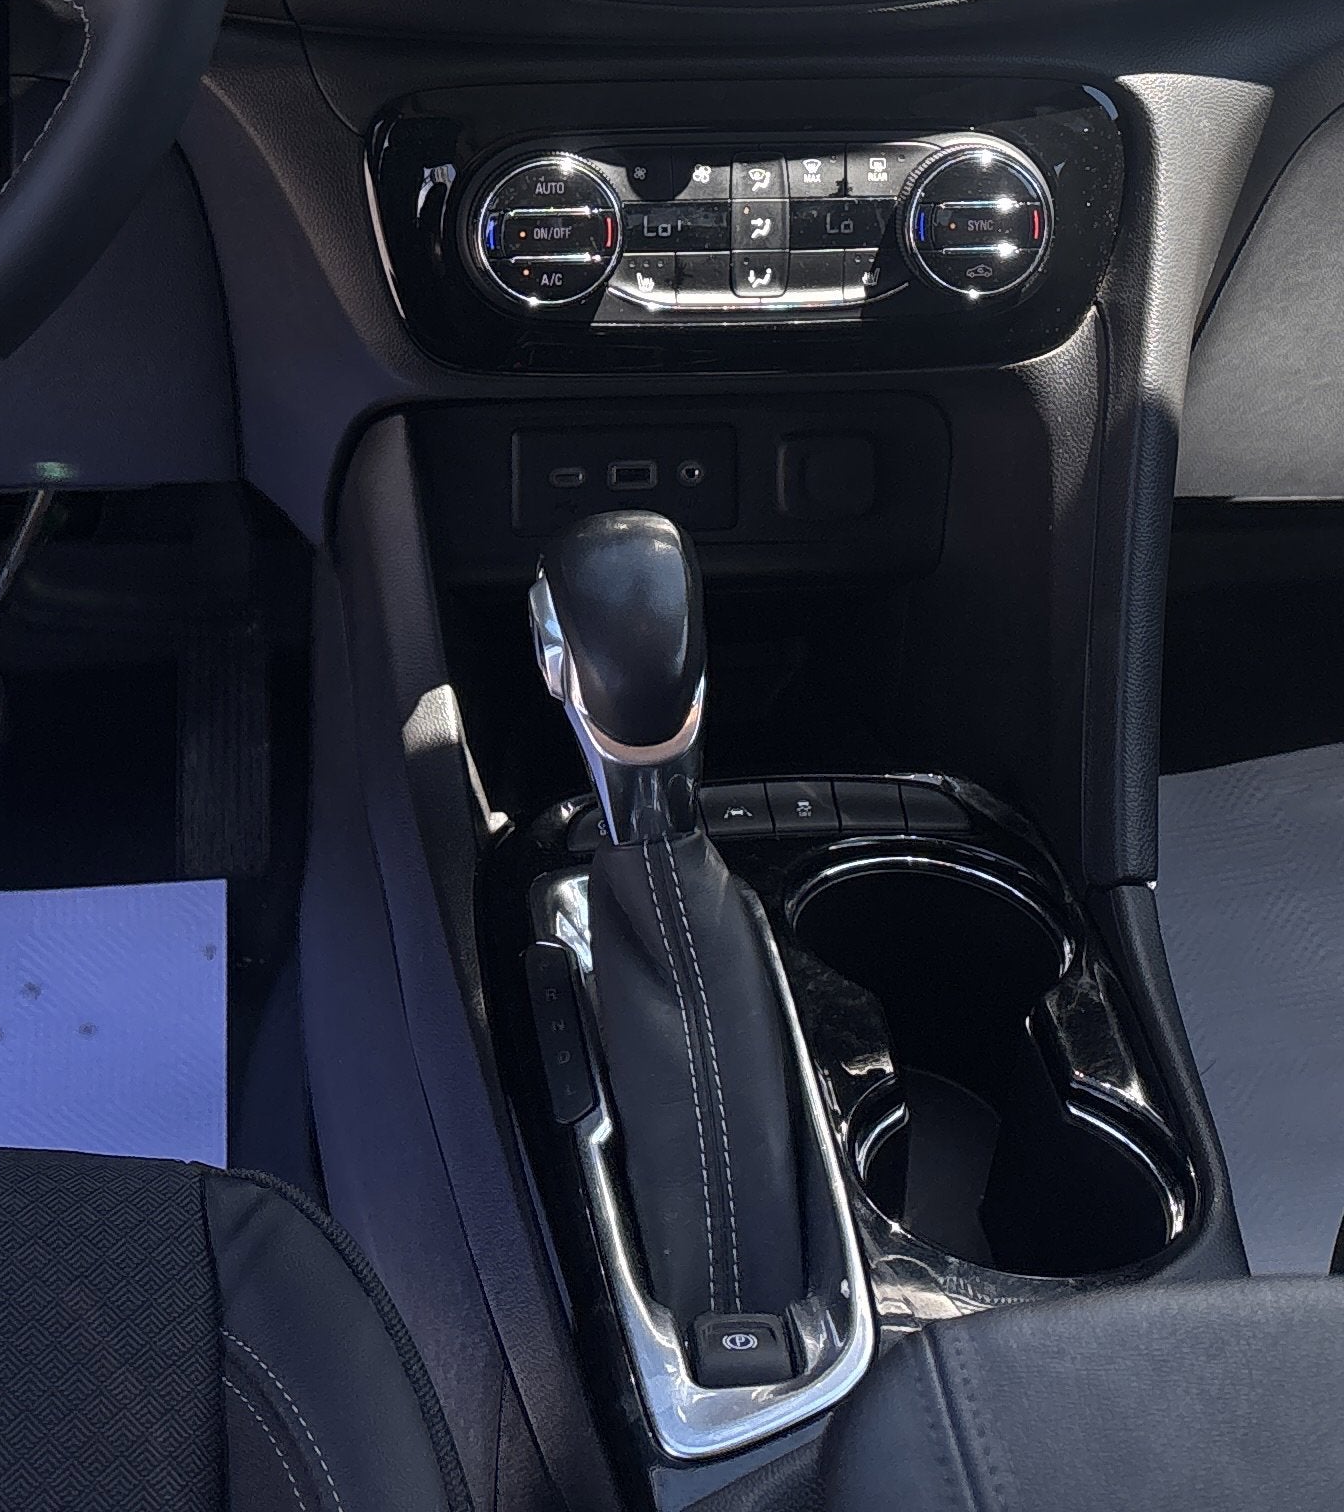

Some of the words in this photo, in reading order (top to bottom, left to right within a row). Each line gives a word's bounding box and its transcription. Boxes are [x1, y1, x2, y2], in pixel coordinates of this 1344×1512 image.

[803, 173, 822, 183] MAX
[867, 172, 888, 182] REAR
[535, 183, 565, 194] AUTO
[967, 220, 994, 231] SYNC
[533, 227, 571, 240] ON/OFF
[541, 273, 563, 286] A/C
